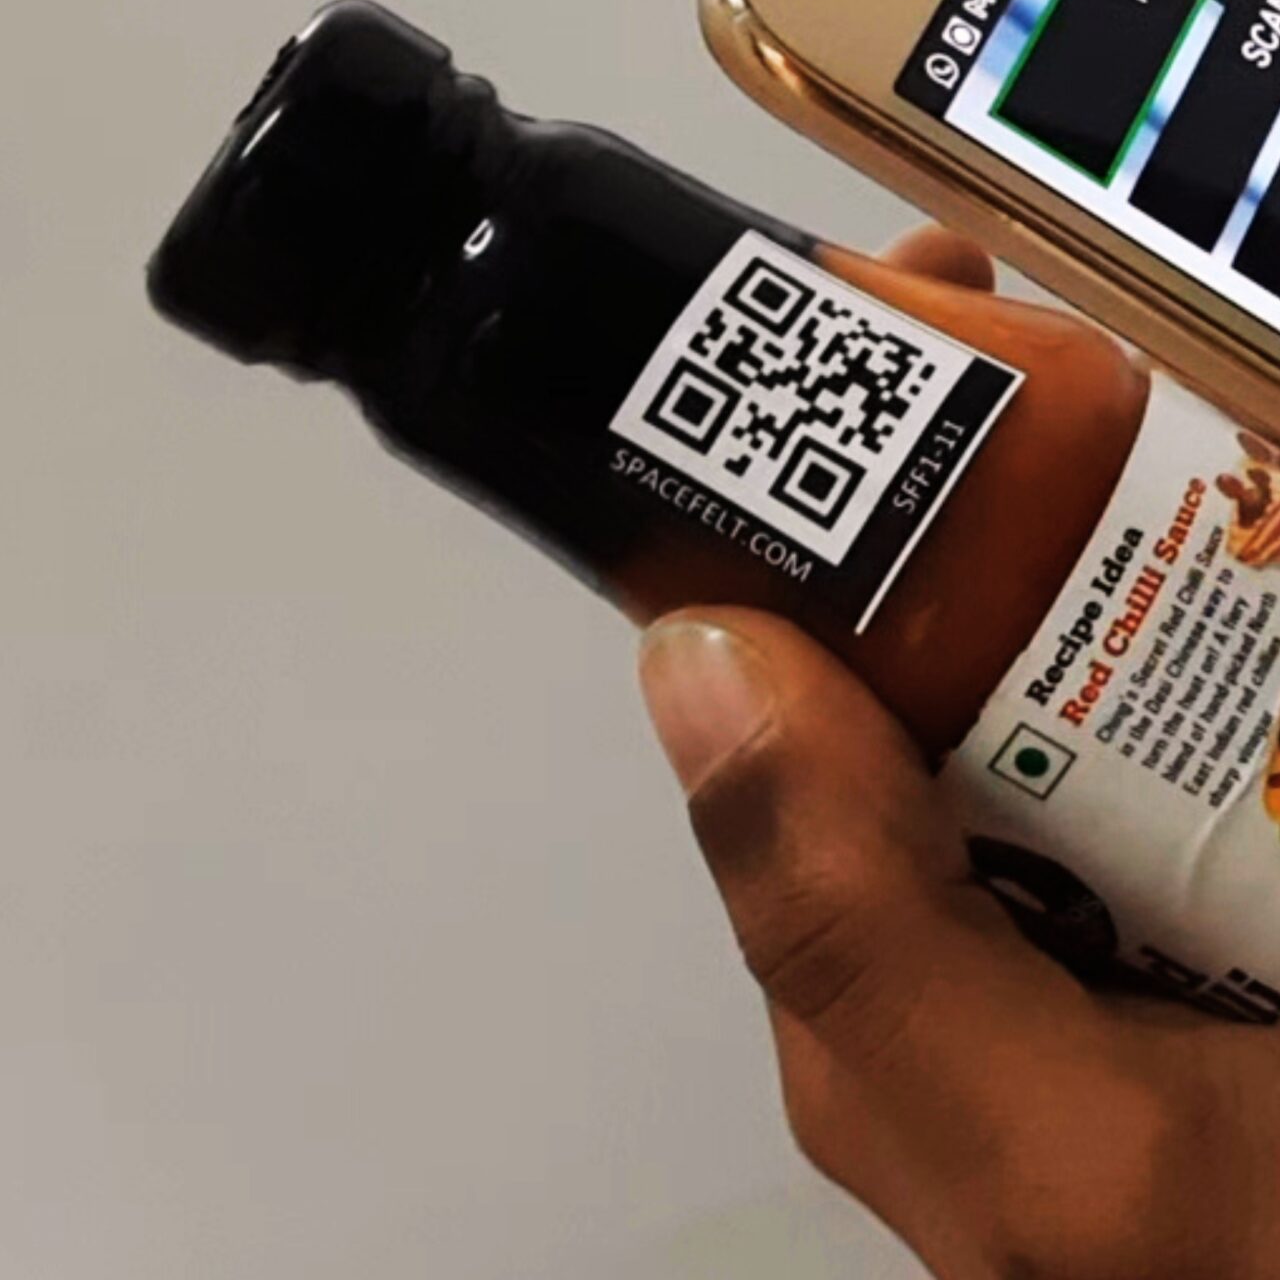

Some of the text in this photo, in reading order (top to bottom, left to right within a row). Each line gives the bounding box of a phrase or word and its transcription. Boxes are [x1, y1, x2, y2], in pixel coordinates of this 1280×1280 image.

[609, 447, 812, 583] SPACEFELT.COM
[894, 418, 965, 515] SFF1-11
[1025, 527, 1144, 707] Recipe Idea
[1059, 477, 1206, 727] Red Chilli Sauce
[1129, 715, 1152, 741] the
[1143, 680, 1173, 715] Desi
[1165, 621, 1207, 679] Chinese
[1203, 587, 1227, 619] way
[1216, 568, 1234, 585] to
[1130, 638, 1168, 688] Secret
[1159, 604, 1187, 638] Red
[1176, 567, 1204, 605] Chilli
[1195, 526, 1223, 568] Sauce
[1212, 631, 1230, 646] A
[1220, 596, 1250, 630] fiery
[1160, 740, 1196, 784] blend
[1190, 721, 1206, 742] of
[1247, 591, 1278, 634] North
[1162, 711, 1186, 737] the
[1176, 675, 1206, 710] heat
[1141, 738, 1170, 769] turn
[1182, 761, 1214, 797] East
[1206, 715, 1242, 761] Indian
[1236, 686, 1257, 714] red
[1208, 709, 1273, 808] sharp vinegar
